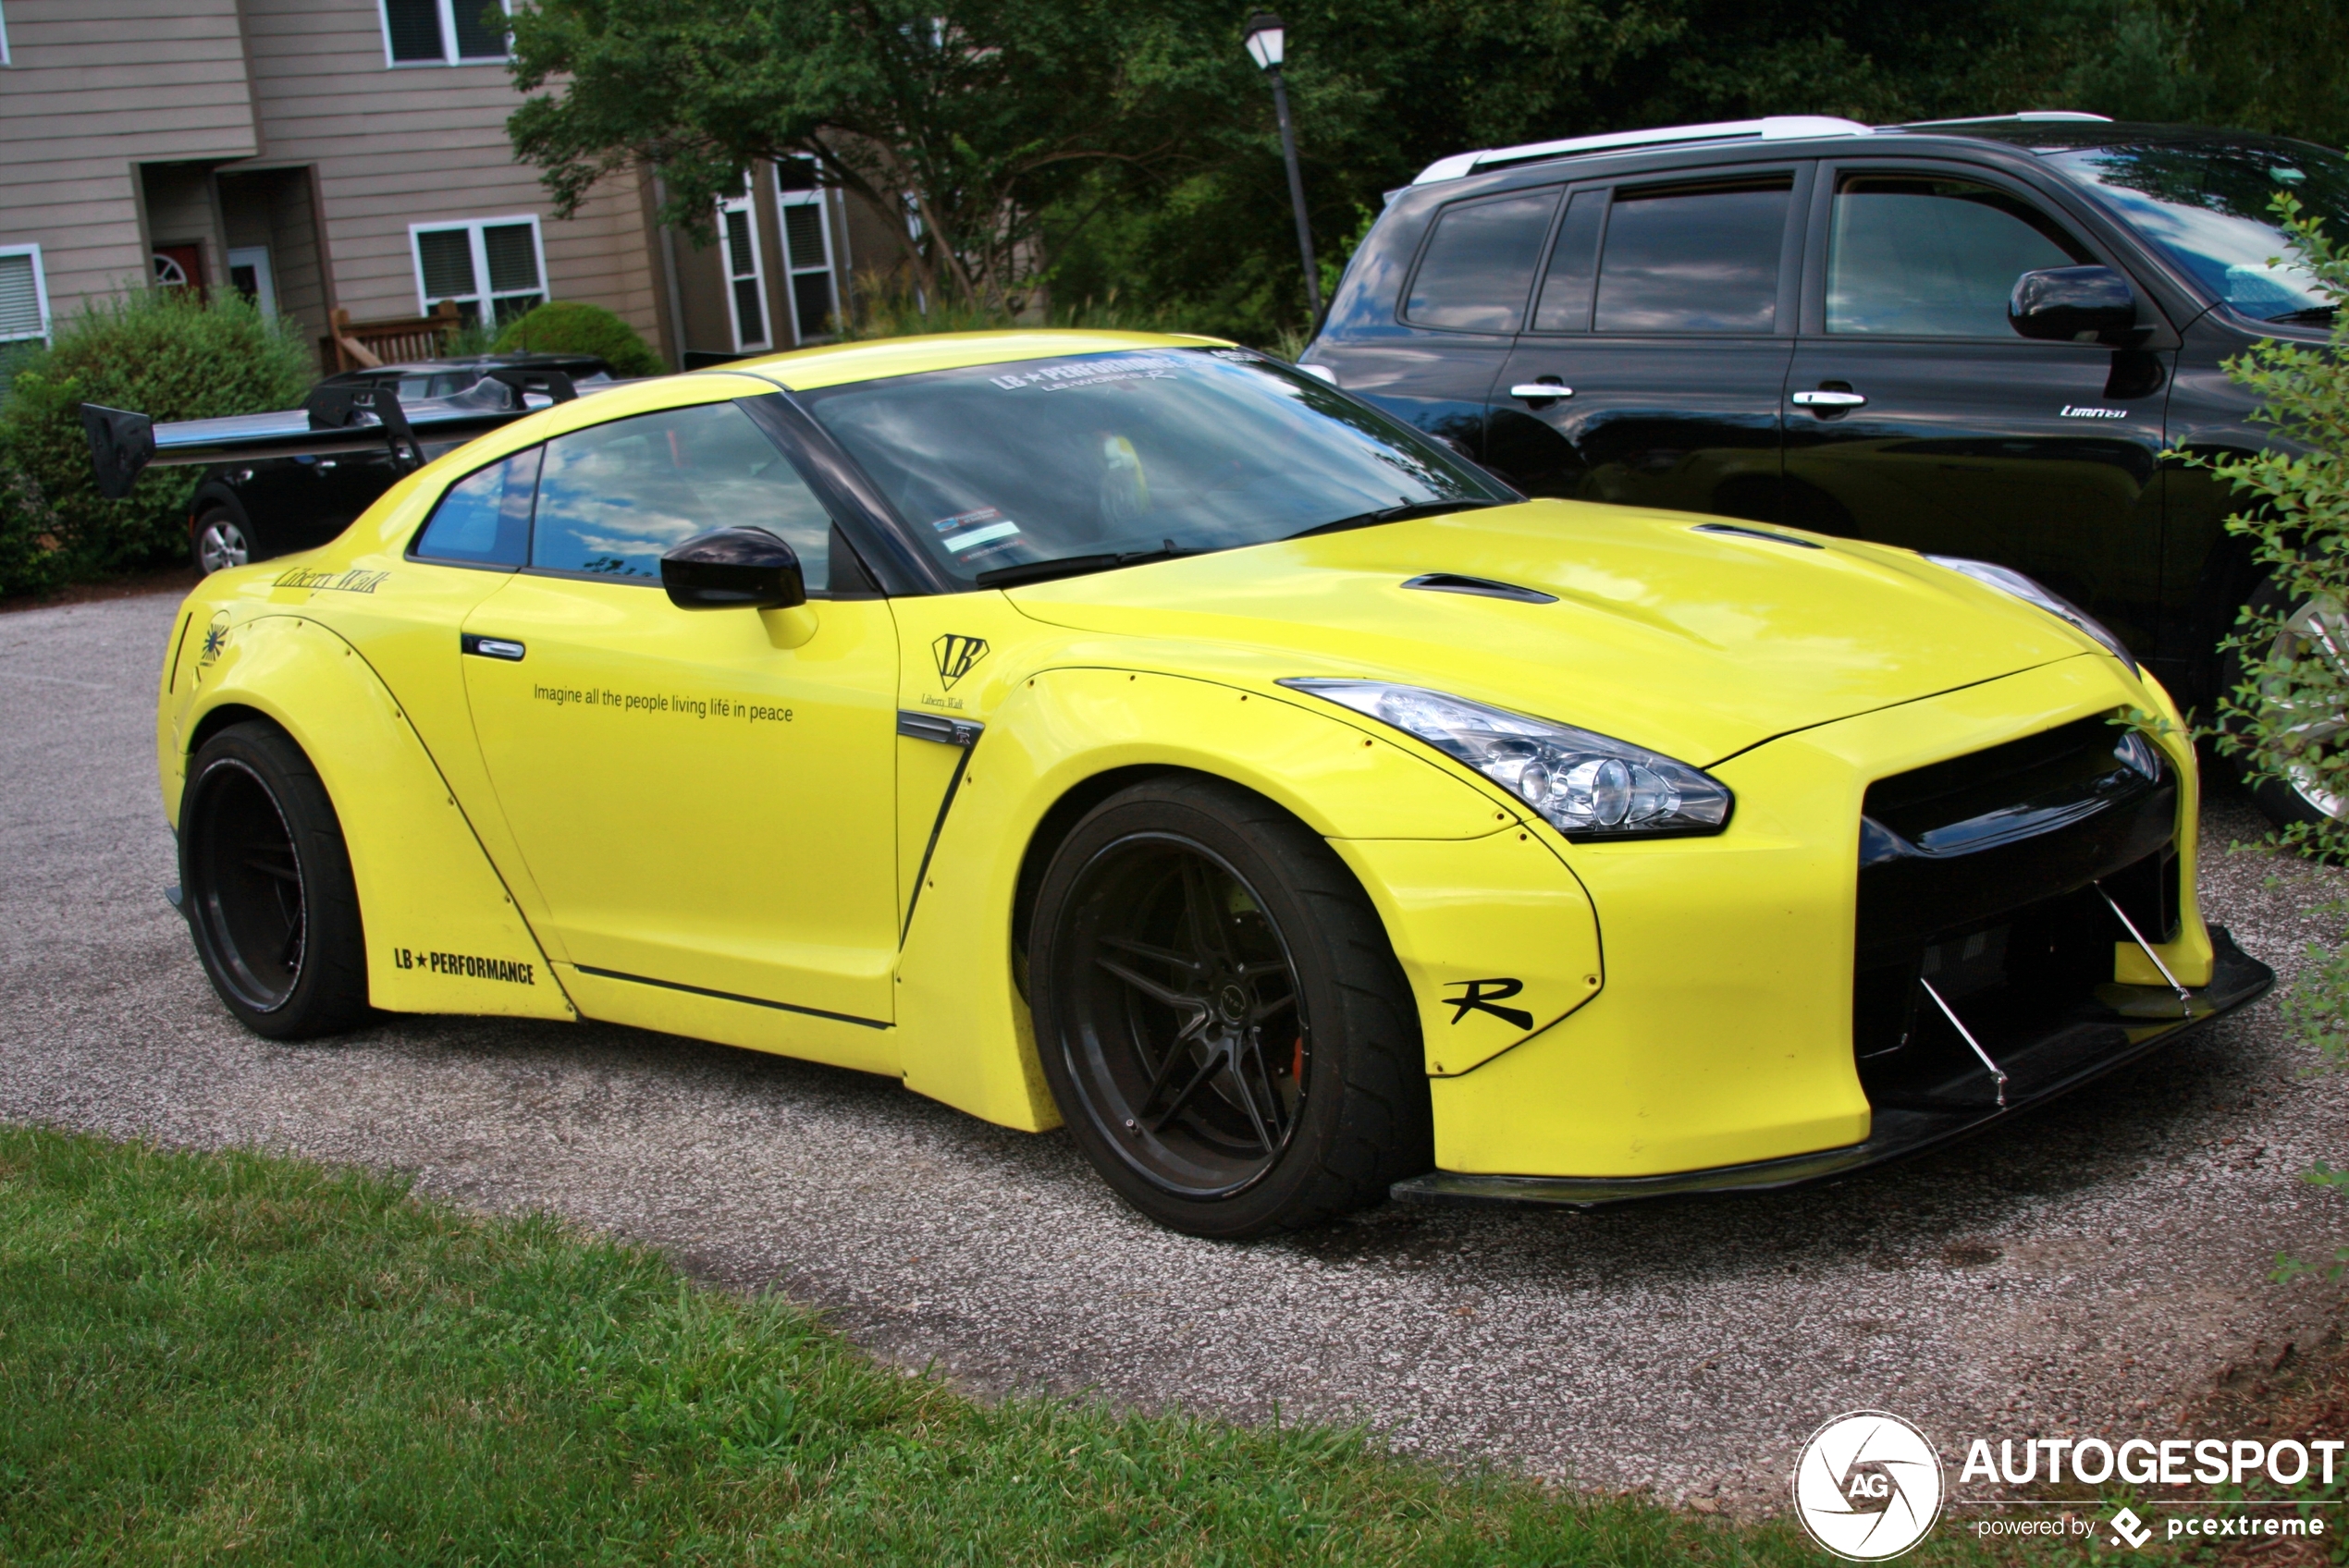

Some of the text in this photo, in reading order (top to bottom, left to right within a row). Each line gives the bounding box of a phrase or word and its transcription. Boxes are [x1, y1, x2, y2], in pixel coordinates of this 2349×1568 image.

[989, 357, 1187, 391] LB PERFORMANCE
[271, 566, 391, 597] Liberty Walk
[535, 683, 583, 706] Imagine
[585, 688, 599, 704] all
[602, 689, 622, 706] the
[625, 692, 669, 714] people
[671, 694, 707, 719] living
[733, 700, 745, 718] in
[750, 705, 793, 724] peace
[921, 692, 964, 710] Liberty Walk
[394, 948, 535, 986] LB PERFORMANCE
[1441, 977, 1533, 1031] R
